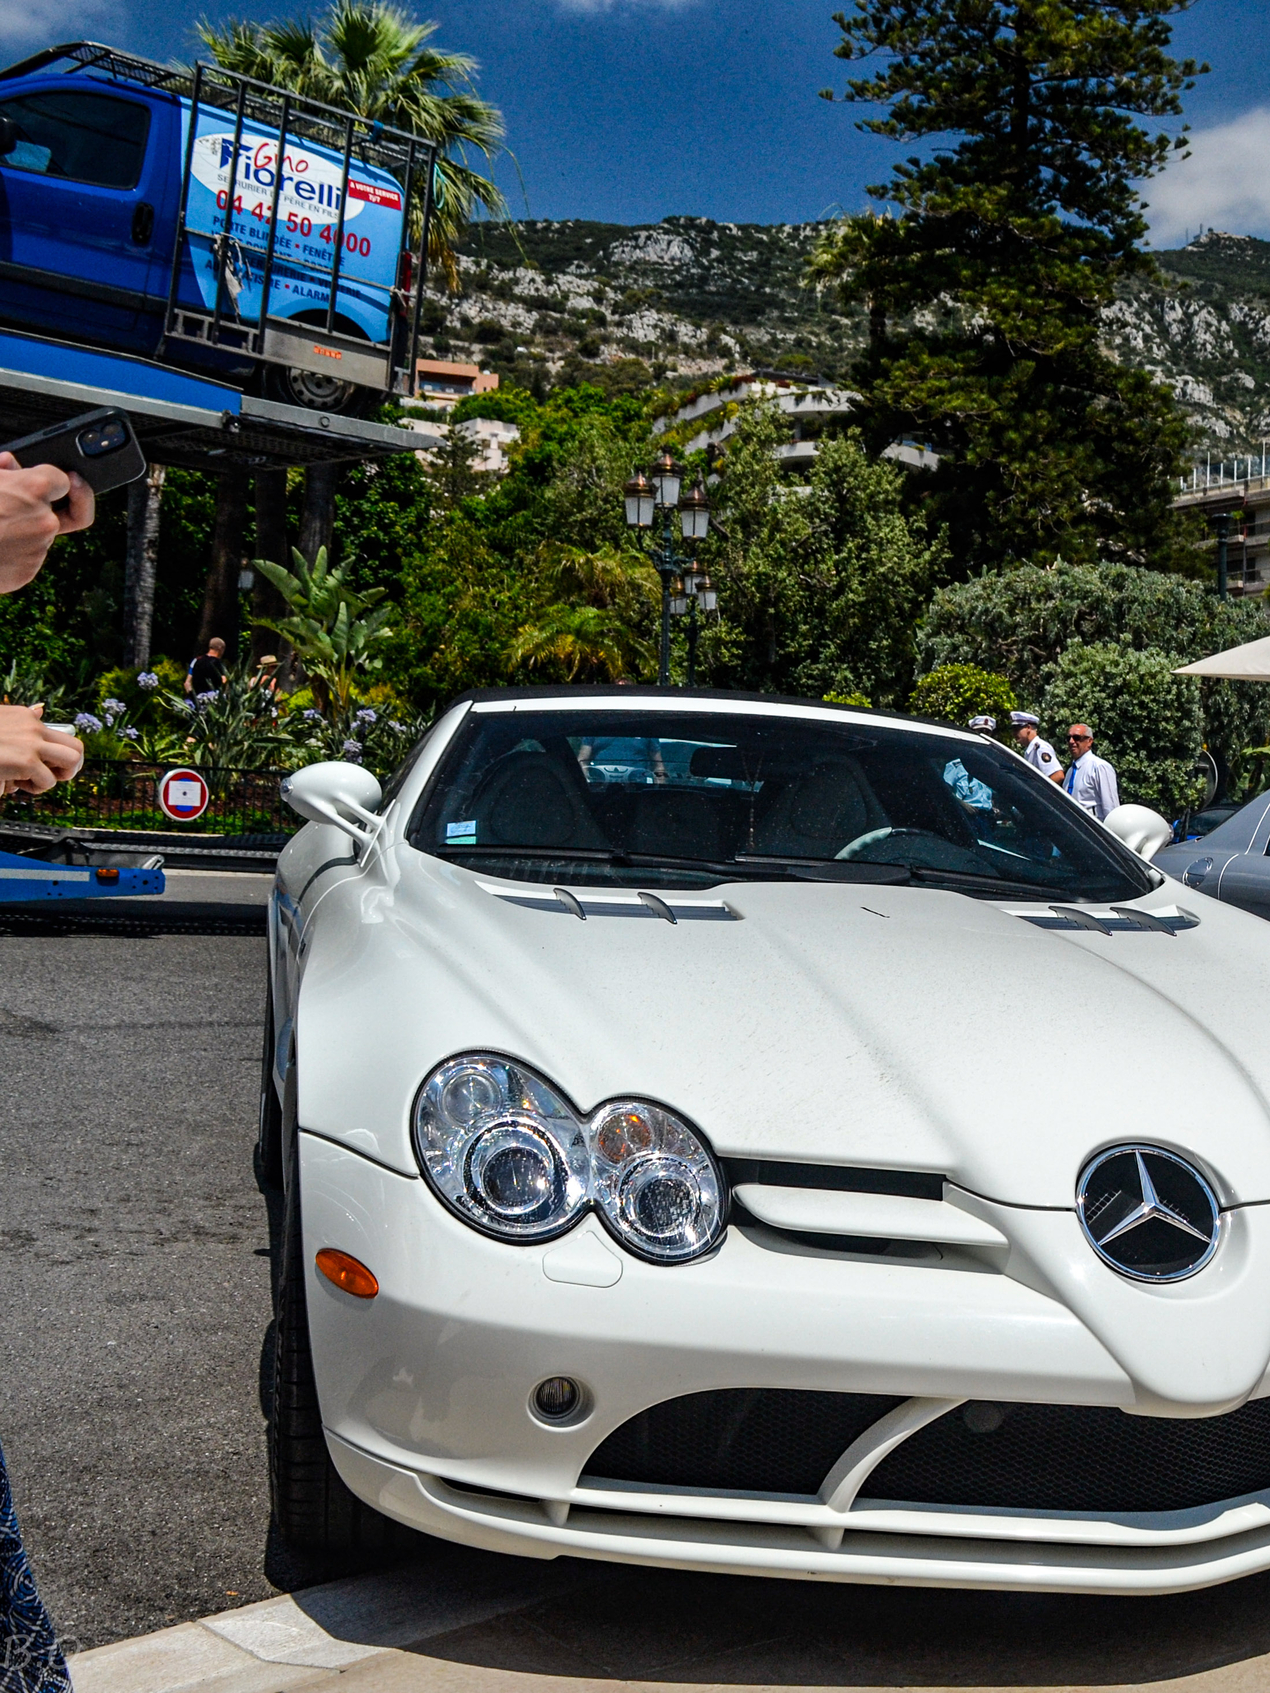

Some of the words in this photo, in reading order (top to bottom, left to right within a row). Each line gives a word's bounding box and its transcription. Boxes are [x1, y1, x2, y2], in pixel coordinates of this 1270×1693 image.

[254, 142, 309, 173] Gino
[308, 202, 320, 213] EN
[286, 210, 312, 237] 50
[303, 243, 345, 267] FENÊTE
